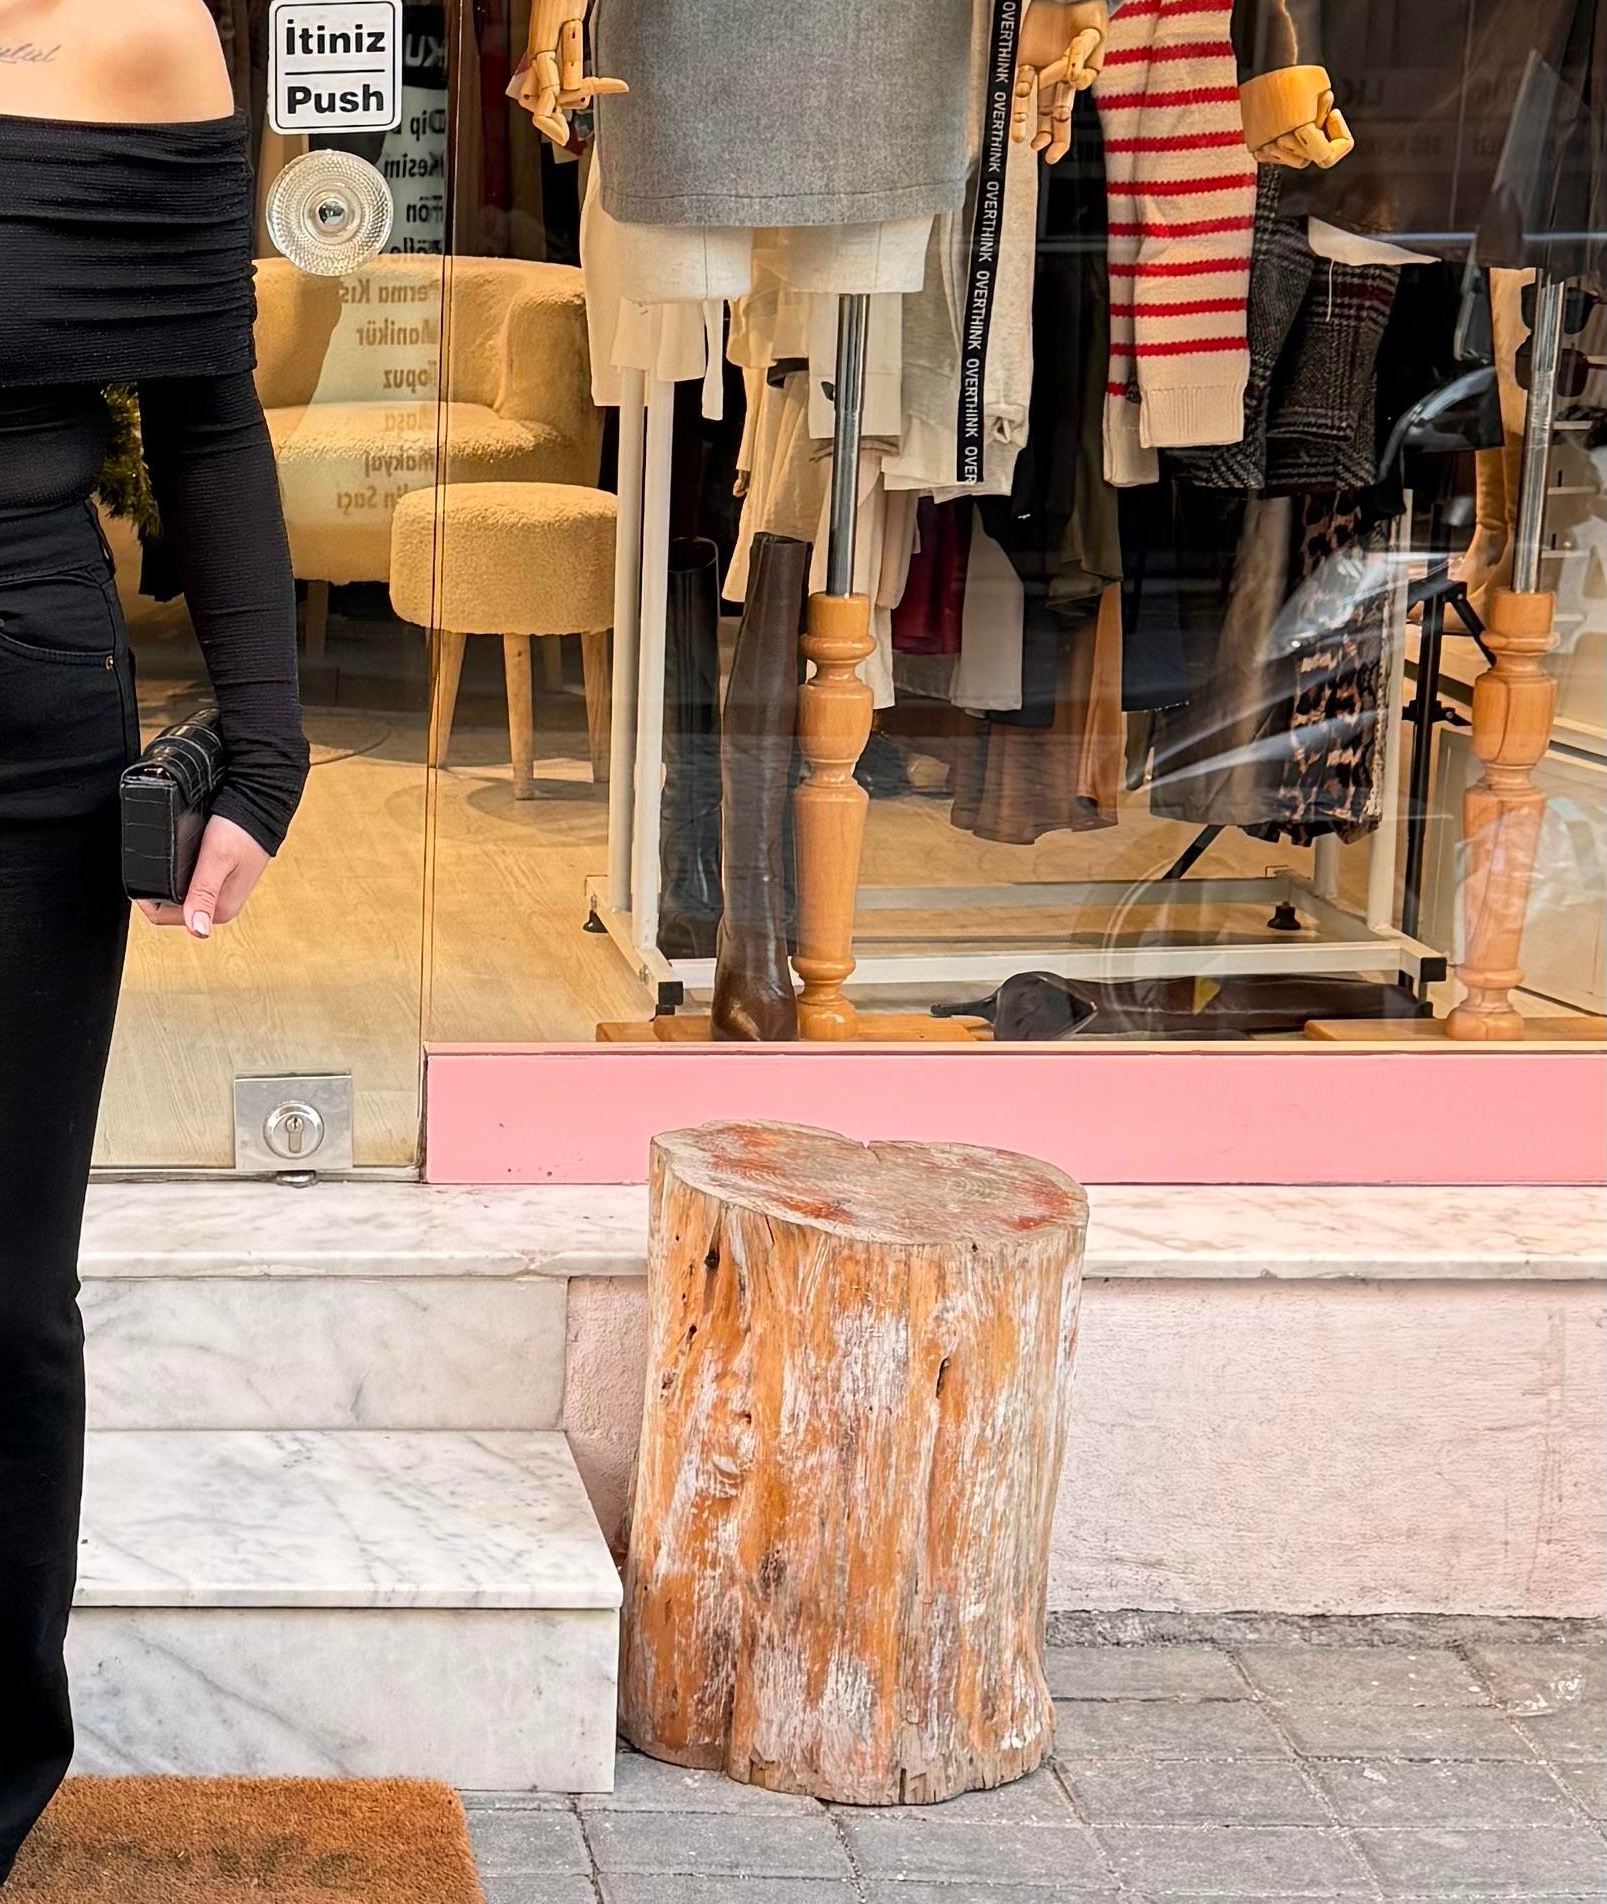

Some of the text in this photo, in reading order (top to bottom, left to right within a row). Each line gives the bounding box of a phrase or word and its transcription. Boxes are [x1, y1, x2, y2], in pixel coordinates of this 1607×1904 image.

[286, 18, 386, 55] İtiniz
[994, 1, 1016, 84] OVERTHINK
[287, 84, 384, 115] Push
[988, 91, 1007, 173] OVERTHINK
[978, 181, 999, 263] OVERTHINK
[967, 270, 991, 351] OVERTHINK
[964, 358, 980, 438] OVERTHINK
